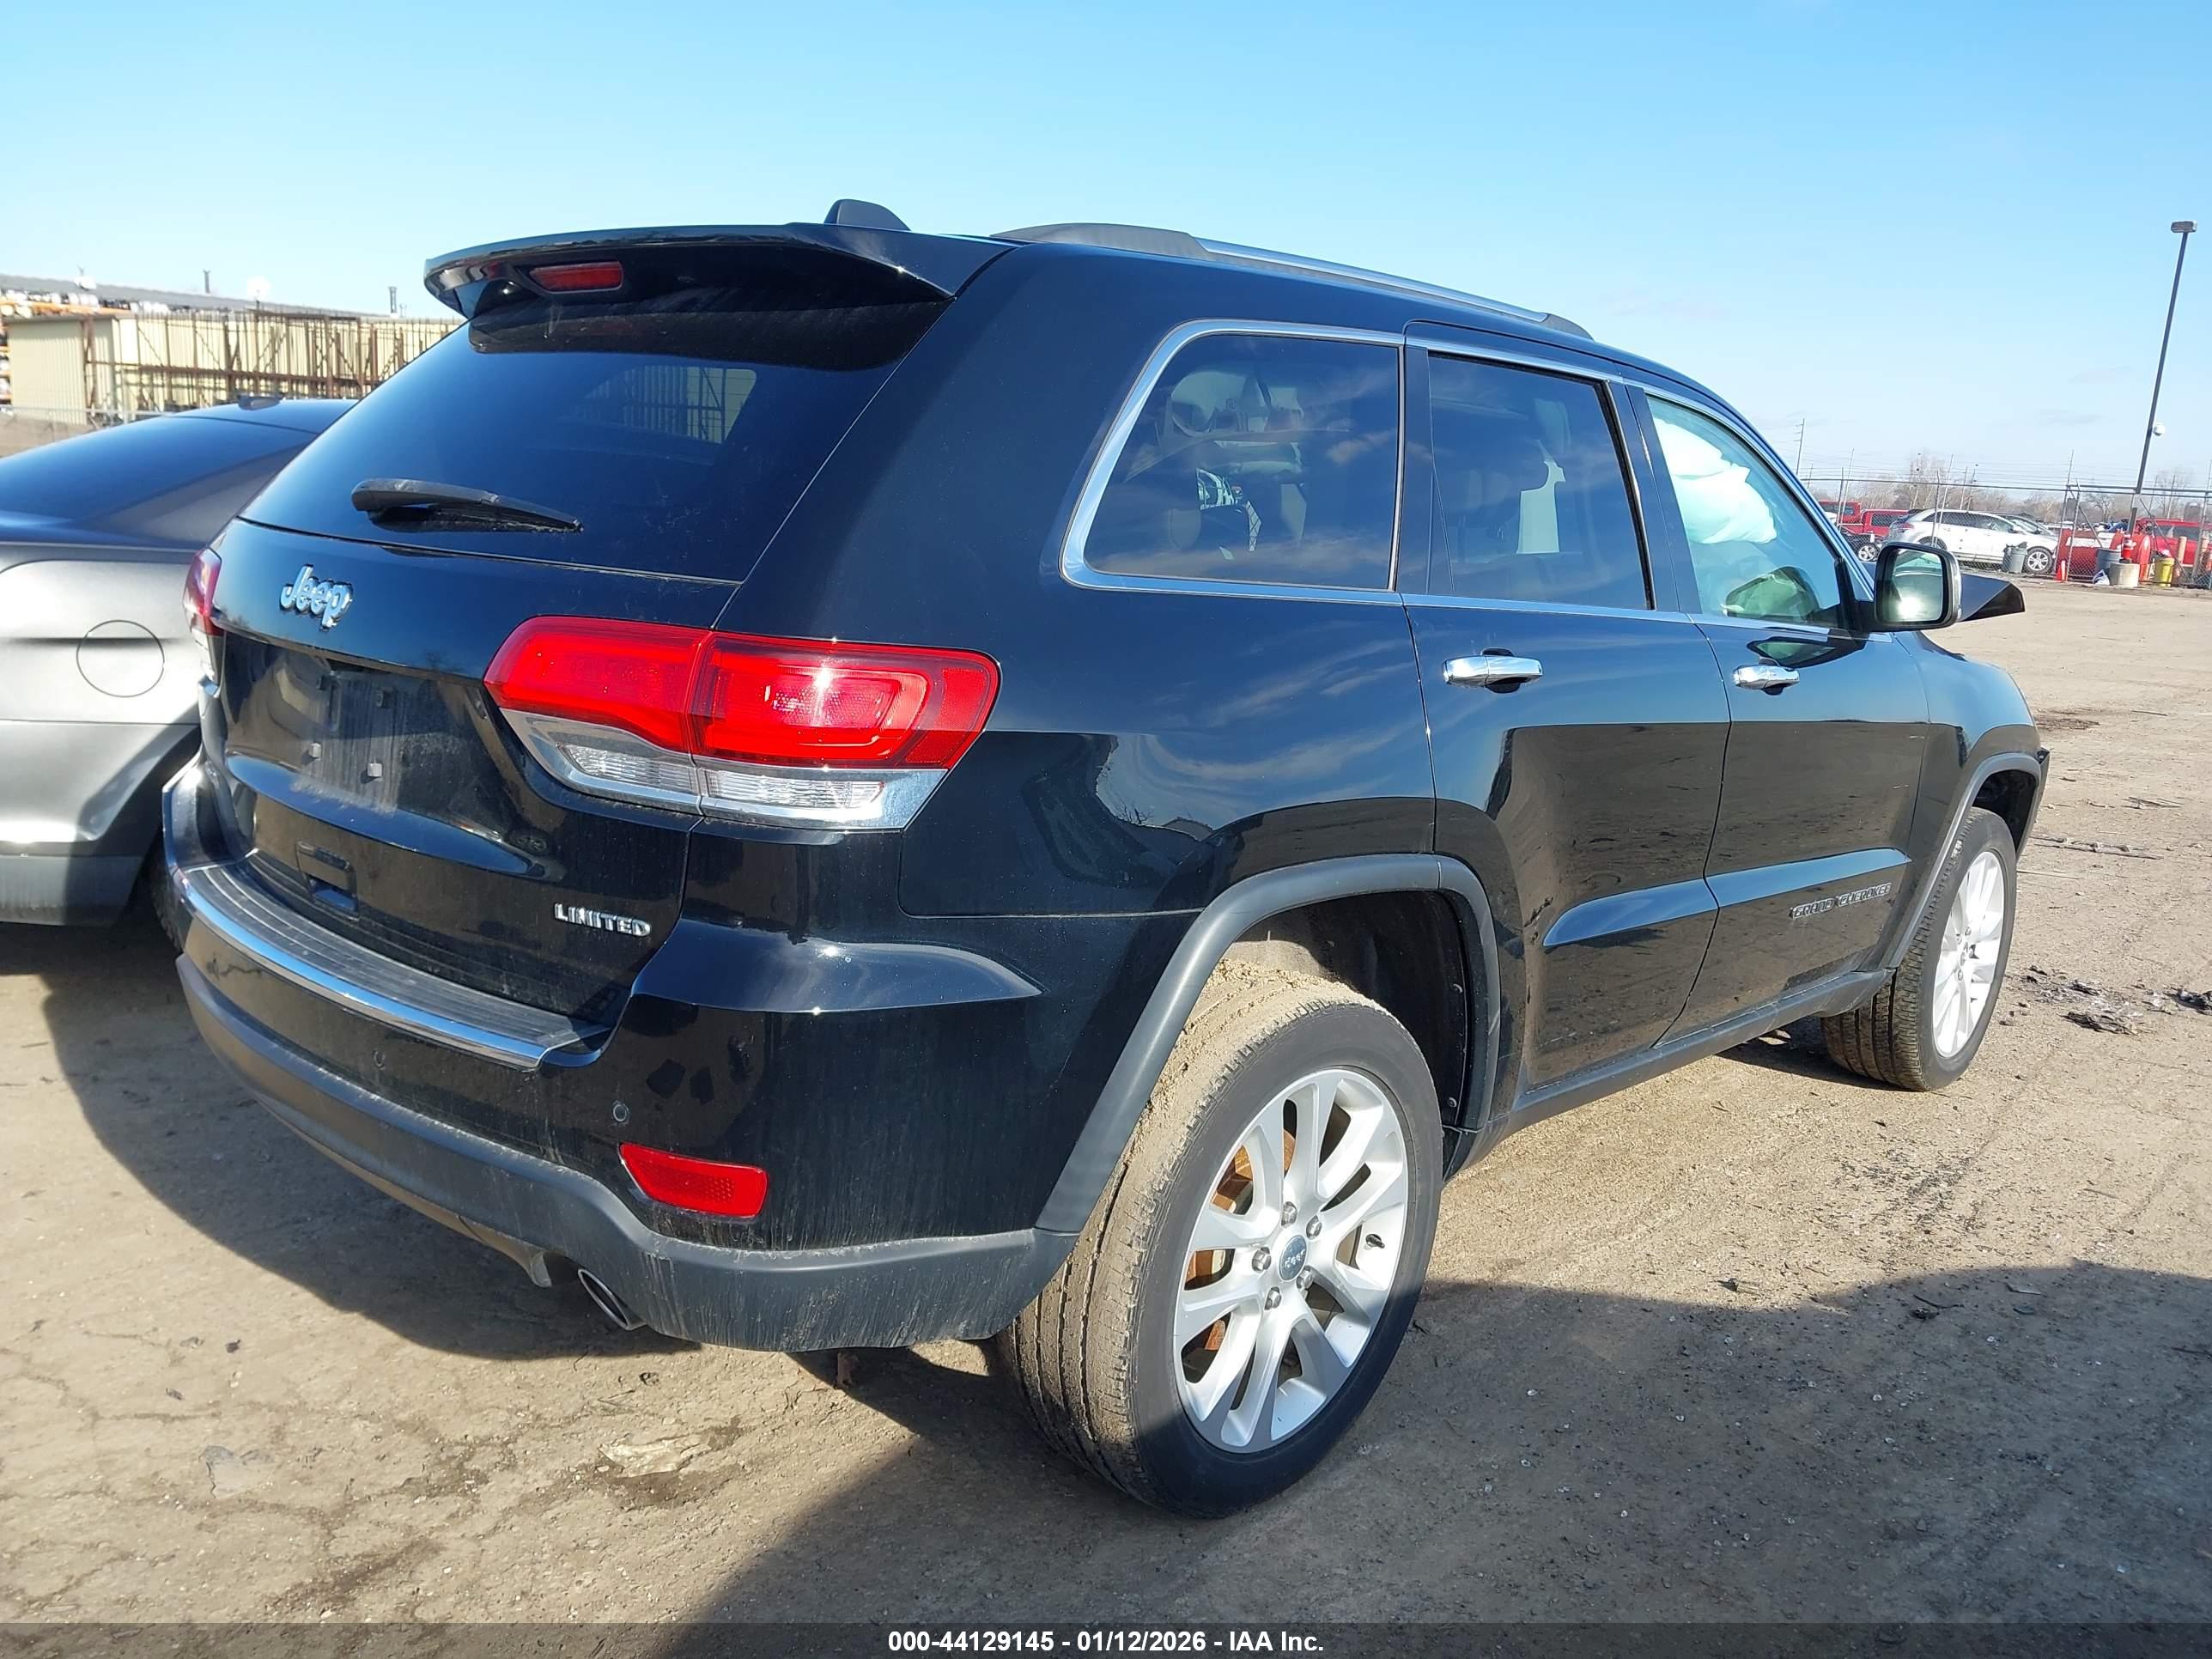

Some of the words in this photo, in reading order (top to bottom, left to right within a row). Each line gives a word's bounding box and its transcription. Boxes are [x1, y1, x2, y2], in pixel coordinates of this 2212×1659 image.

[280, 564, 352, 629] Jeep
[554, 902, 651, 937] LIMITED
[1792, 897, 1835, 920] GRAND
[1837, 882, 1893, 908] CHEROKEE
